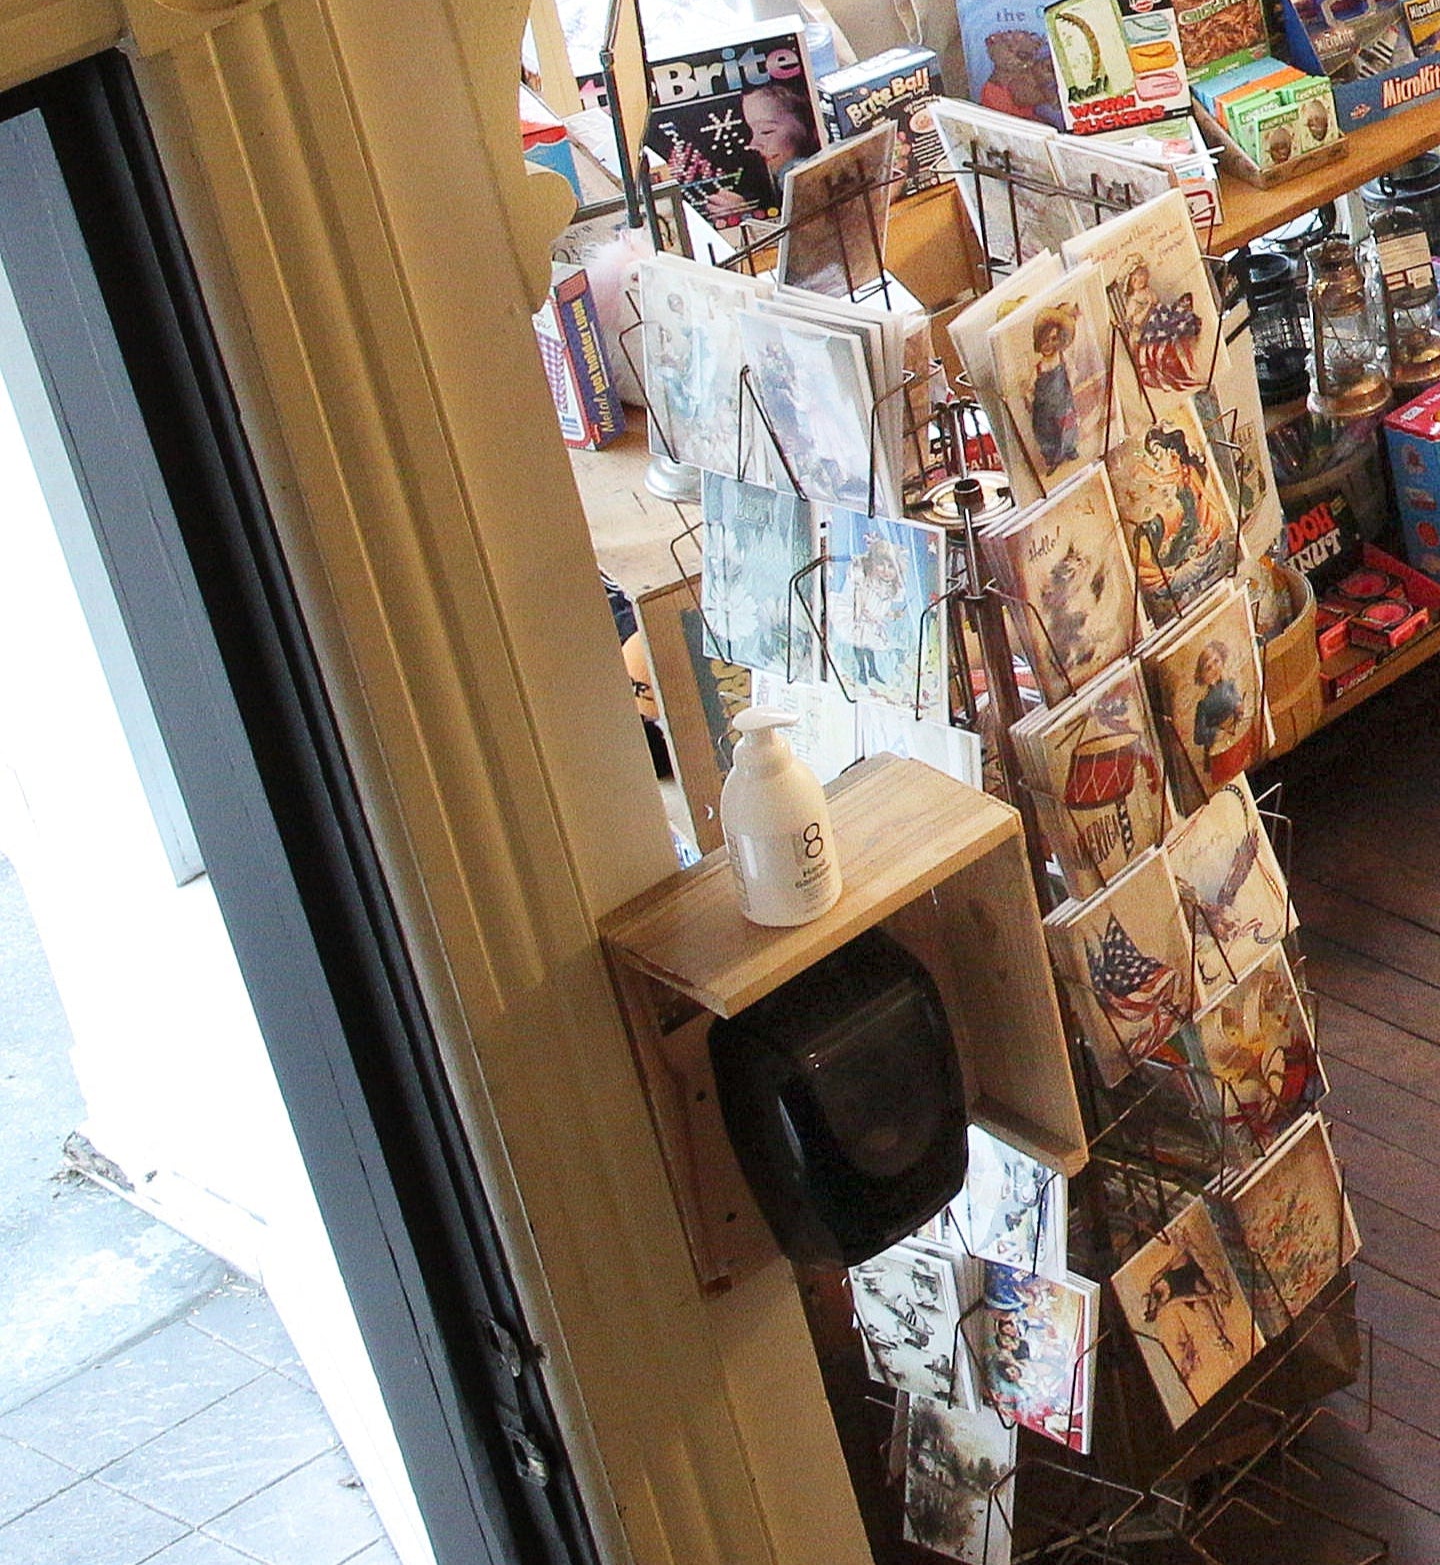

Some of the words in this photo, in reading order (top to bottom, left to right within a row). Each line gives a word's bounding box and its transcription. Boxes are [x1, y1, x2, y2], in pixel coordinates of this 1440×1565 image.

[995, 6, 1026, 23] the
[650, 46, 802, 106] Brite
[1067, 75, 1109, 102] Real!
[1068, 94, 1137, 120] WORM
[1072, 105, 1166, 136] SUCKERS
[803, 822, 824, 859] 8
